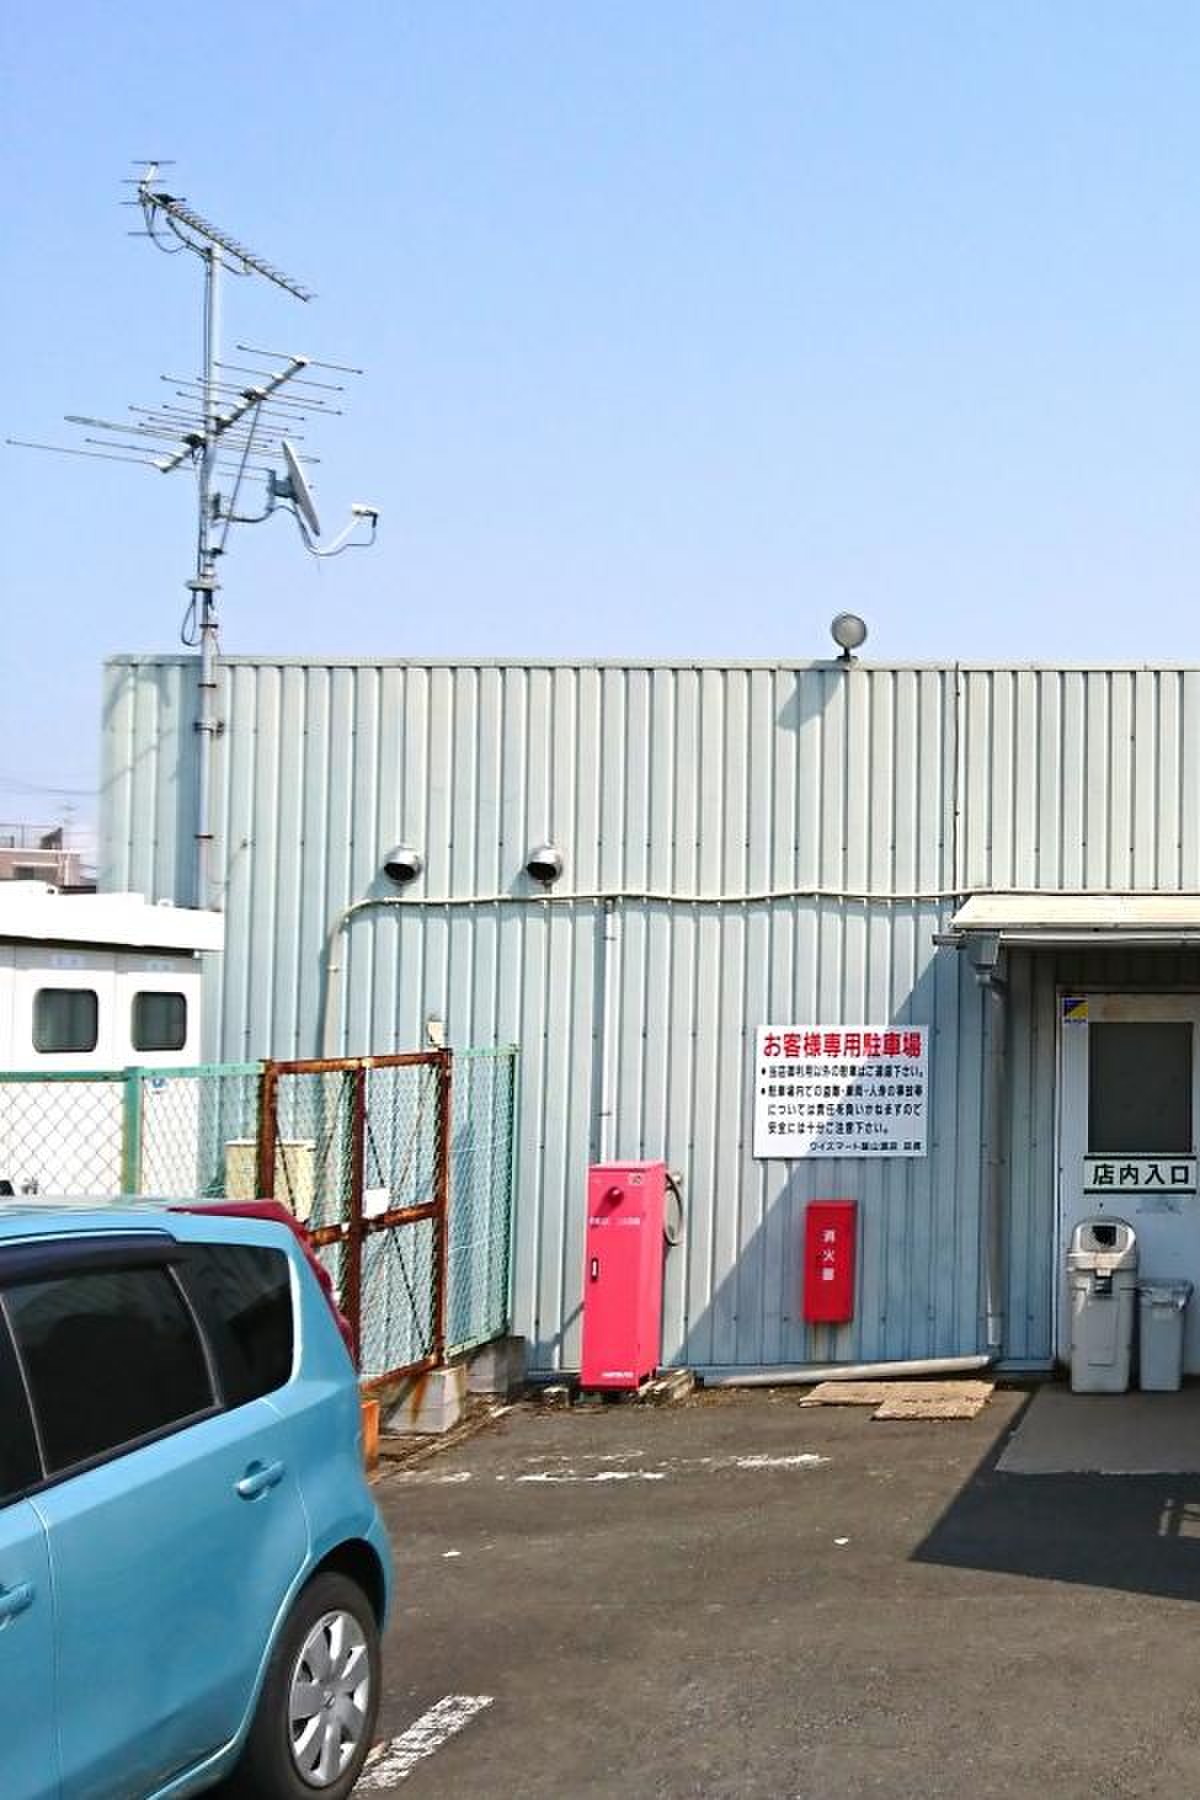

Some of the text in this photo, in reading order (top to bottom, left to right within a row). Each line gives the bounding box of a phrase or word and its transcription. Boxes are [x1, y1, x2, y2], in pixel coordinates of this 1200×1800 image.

[763, 1032, 922, 1058] お客様専用駐車場
[767, 1120, 888, 1135] 安全には十分ご注意下さい。
[1092, 1163, 1189, 1186] 店内入口
